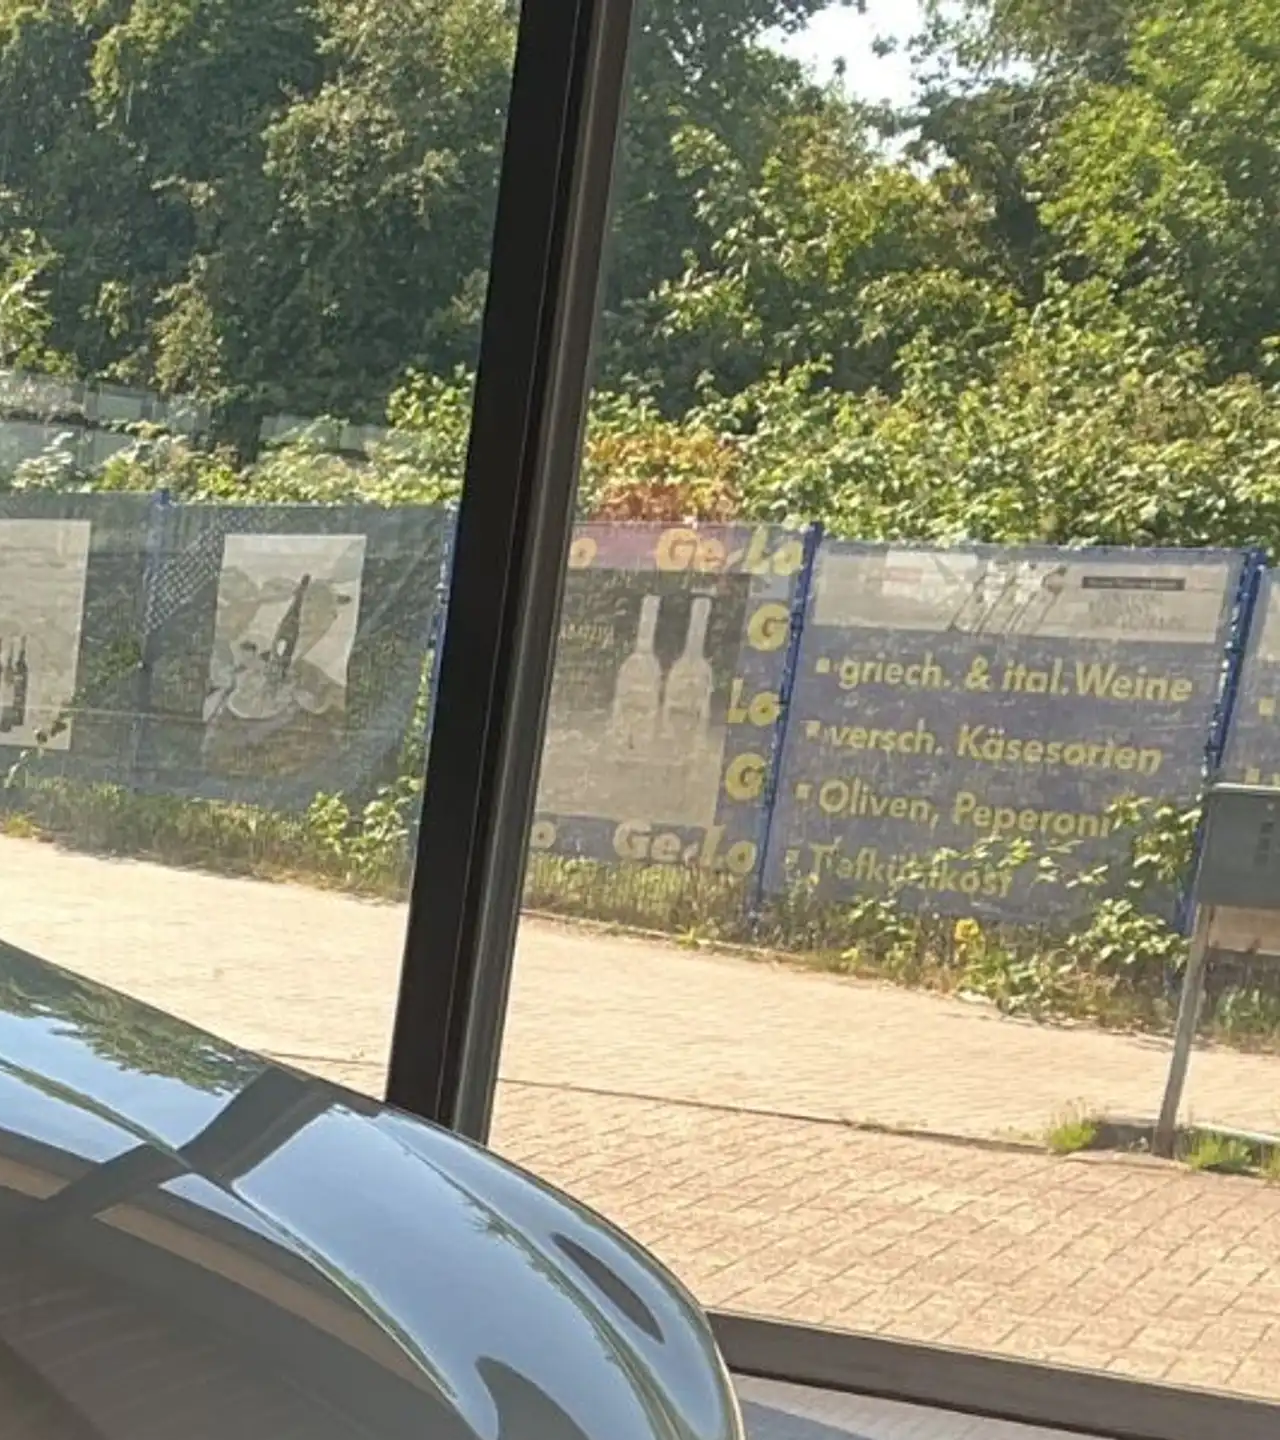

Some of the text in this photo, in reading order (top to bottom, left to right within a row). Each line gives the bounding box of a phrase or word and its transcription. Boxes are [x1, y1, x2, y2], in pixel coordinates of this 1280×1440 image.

[839, 654, 1193, 703] griech. & ital. Weine
[830, 716, 1163, 776] versch. Käsesorten
[819, 779, 1112, 840] Oliven, Peperoni
